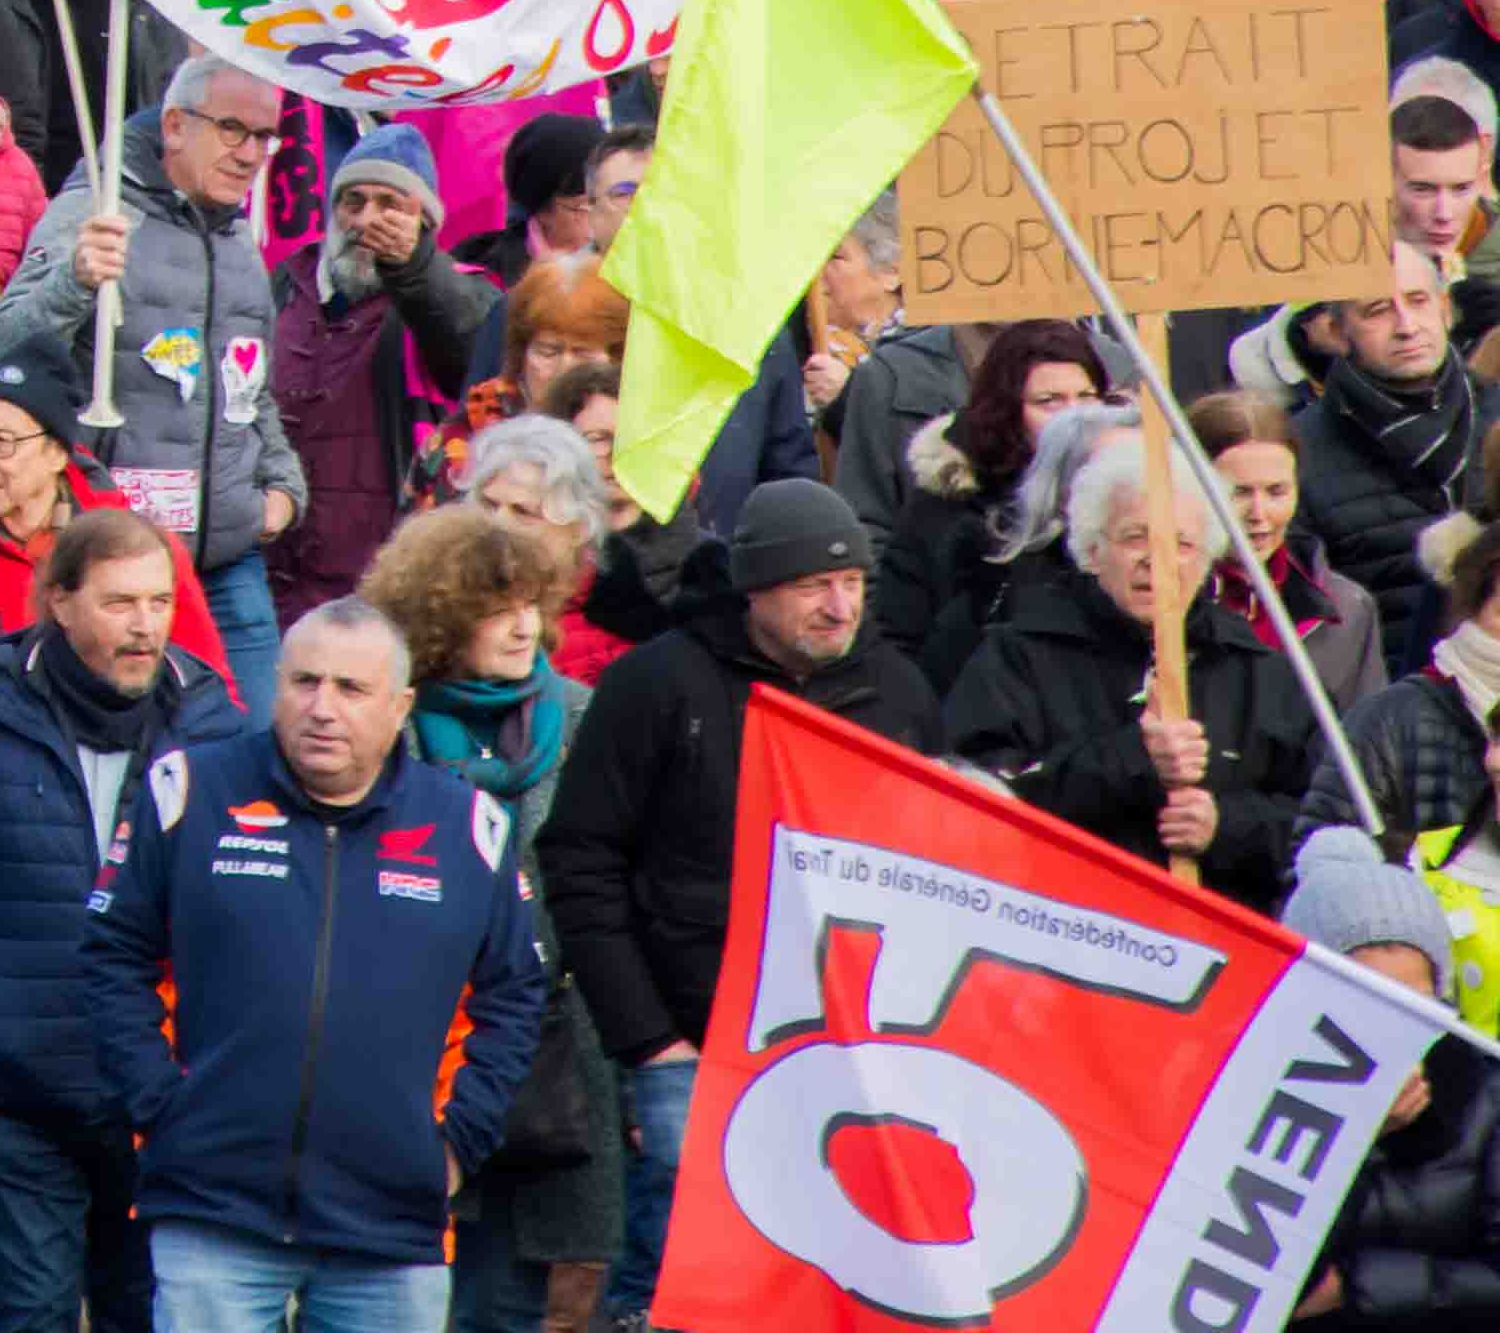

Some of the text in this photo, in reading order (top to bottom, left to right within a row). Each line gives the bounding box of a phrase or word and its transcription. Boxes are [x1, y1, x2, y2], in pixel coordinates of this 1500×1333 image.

[972, 4, 1335, 103] ETRAIT
[934, 106, 1364, 200] DU PROJET
